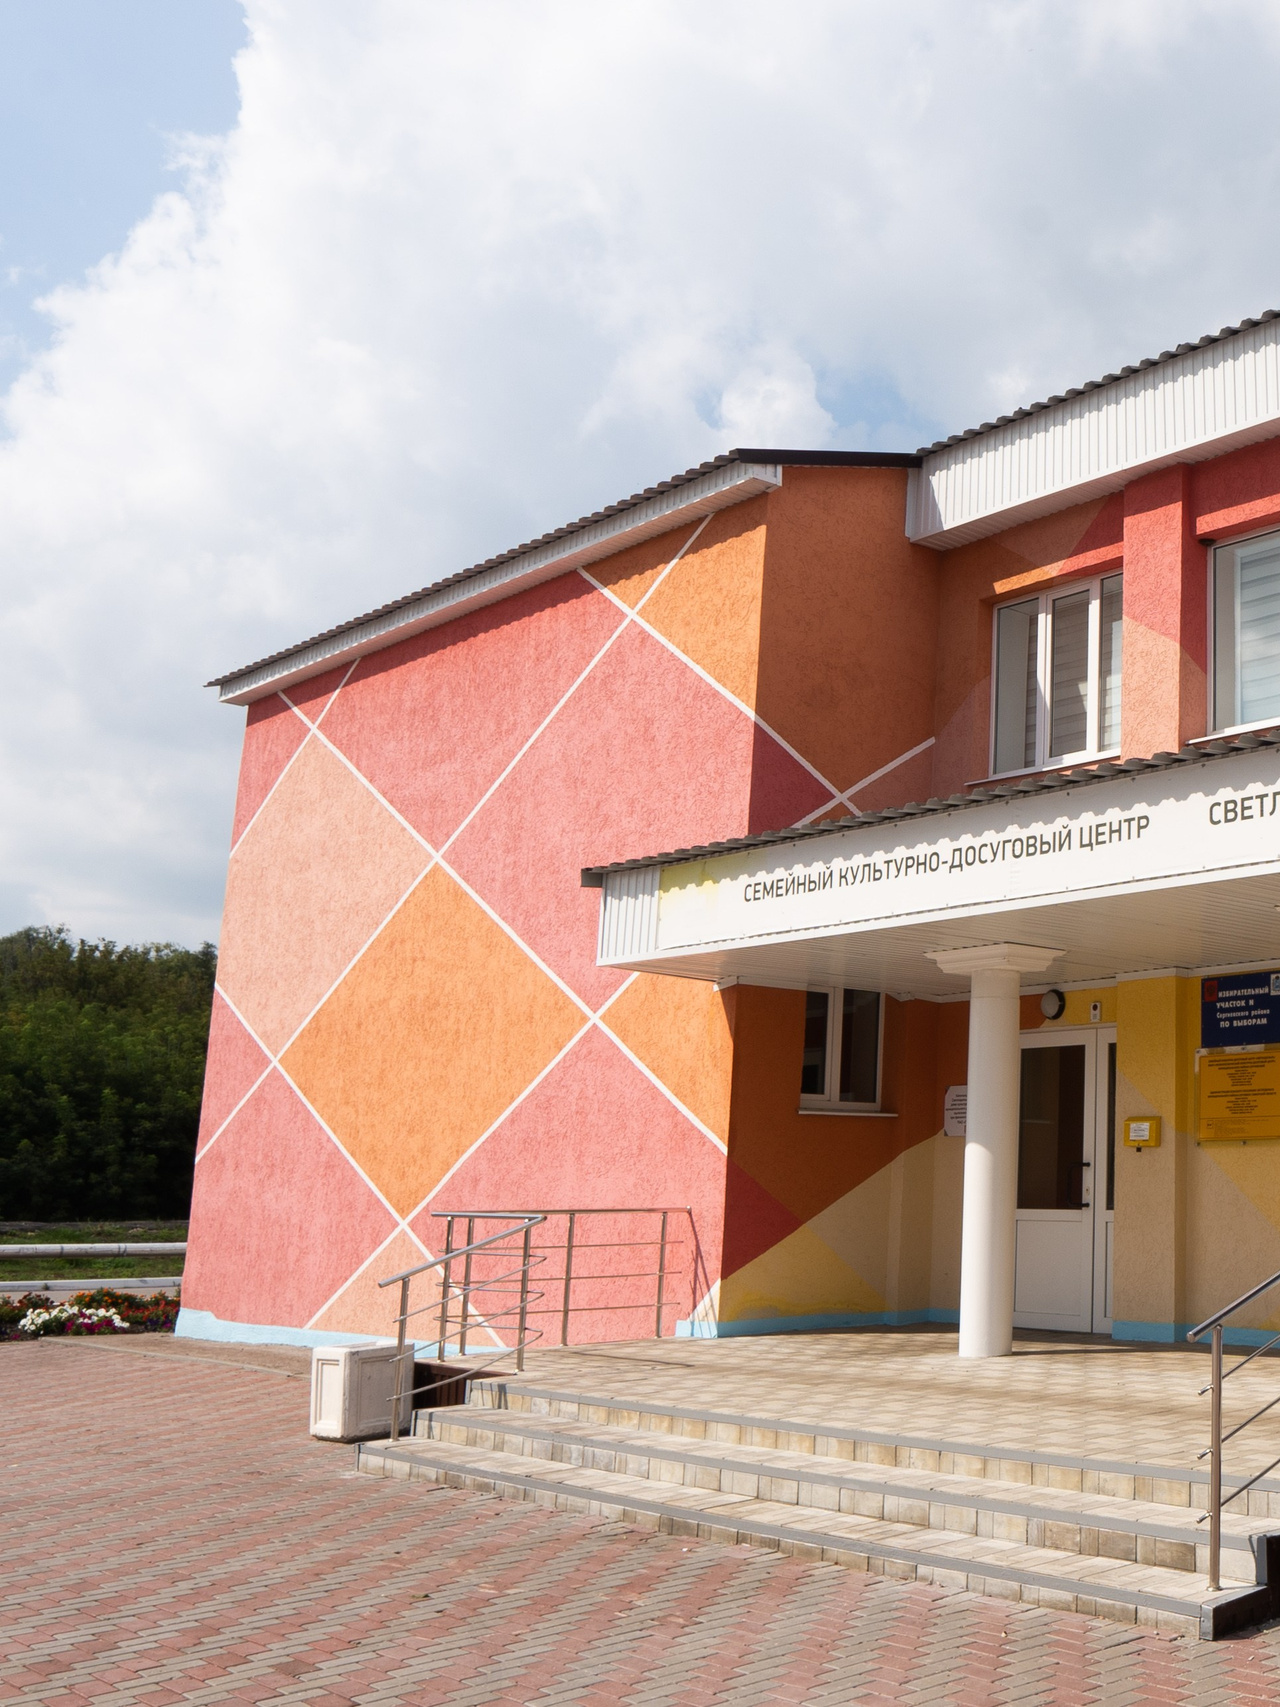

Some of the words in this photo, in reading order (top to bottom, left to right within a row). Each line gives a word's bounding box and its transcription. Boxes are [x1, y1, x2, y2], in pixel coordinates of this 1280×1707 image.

[744, 864, 834, 902] СЕМЕЙНЫЙ
[838, 824, 1072, 887] КУЛЬТУРНО-ДОСУГОВЫЙ
[1079, 815, 1150, 851] ЦЕНТР
[1218, 986, 1269, 998] ИЗБИРАТЕЛЬНЫЙ
[1216, 1000, 1246, 1009] УЧАСТОК
[1251, 1008, 1270, 1017] района
[1220, 1020, 1230, 1028] ПО
[1233, 1018, 1267, 1027] ВЫБОРАМ
